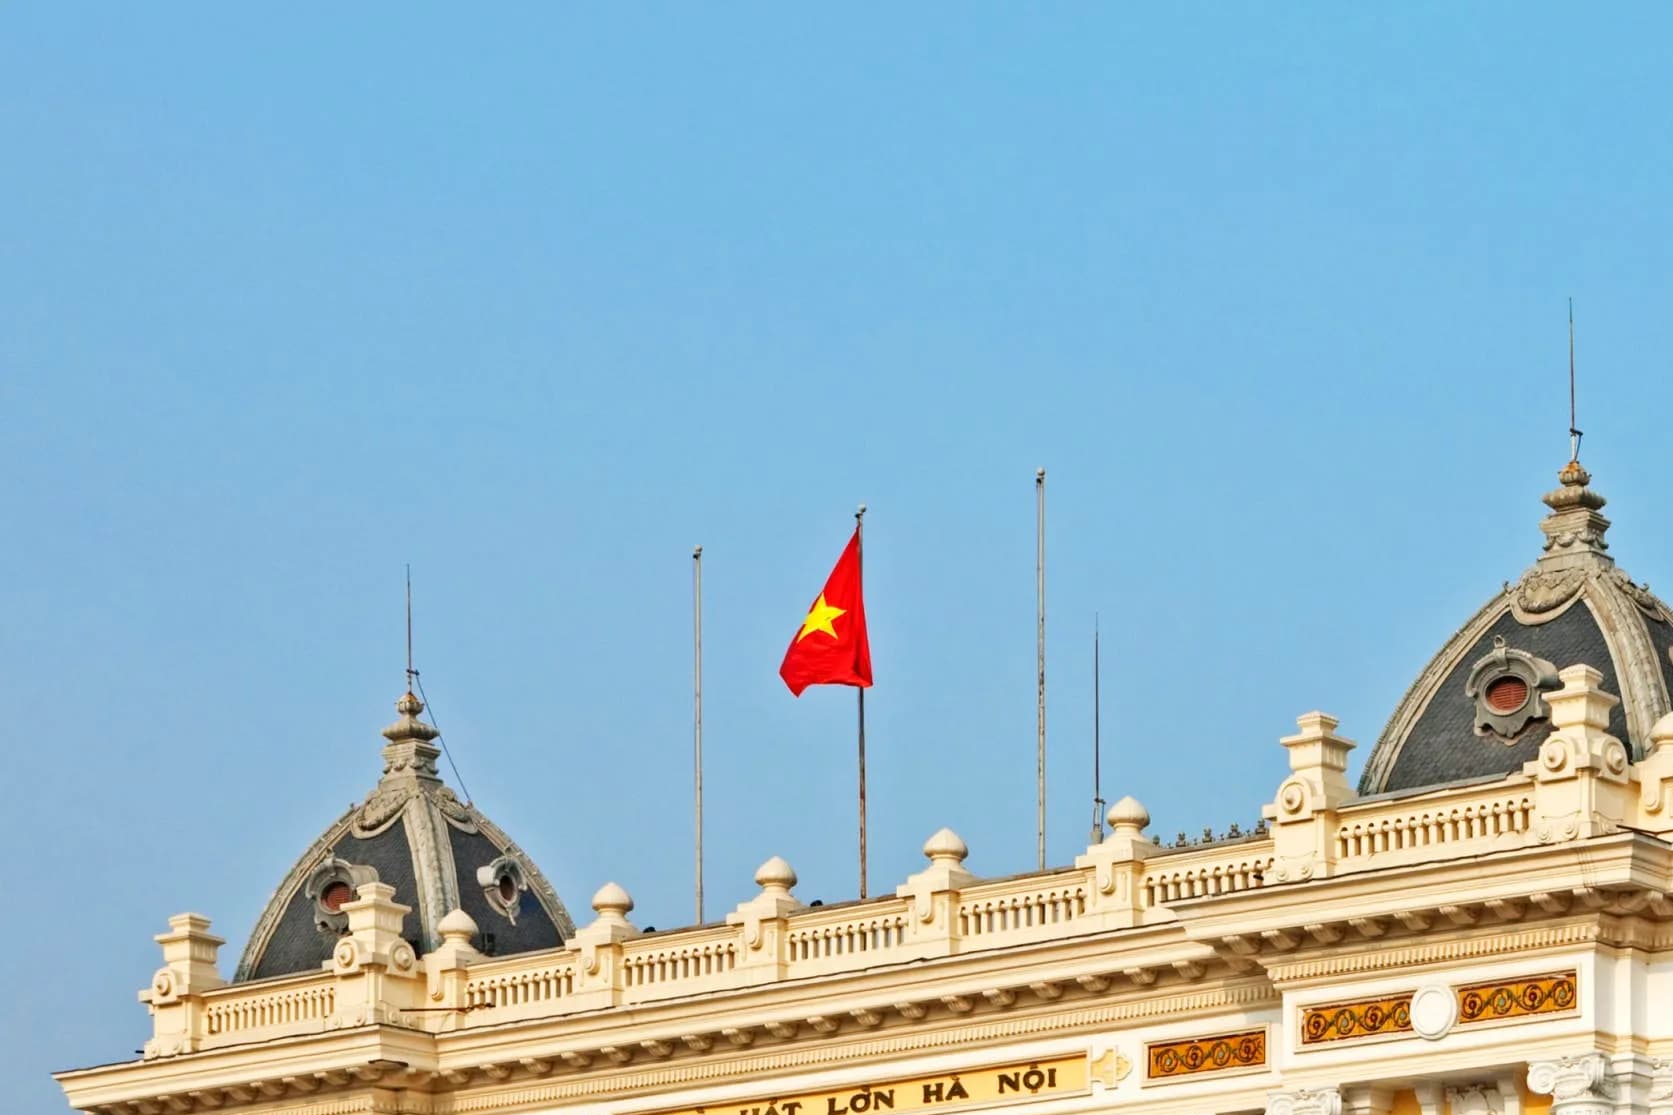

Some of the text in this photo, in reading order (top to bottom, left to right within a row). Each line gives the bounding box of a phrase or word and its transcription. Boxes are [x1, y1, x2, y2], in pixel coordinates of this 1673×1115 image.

[828, 1085, 894, 1115] LỚN
[923, 1075, 969, 1103] HÀ
[998, 1063, 1056, 1093] NỘI
